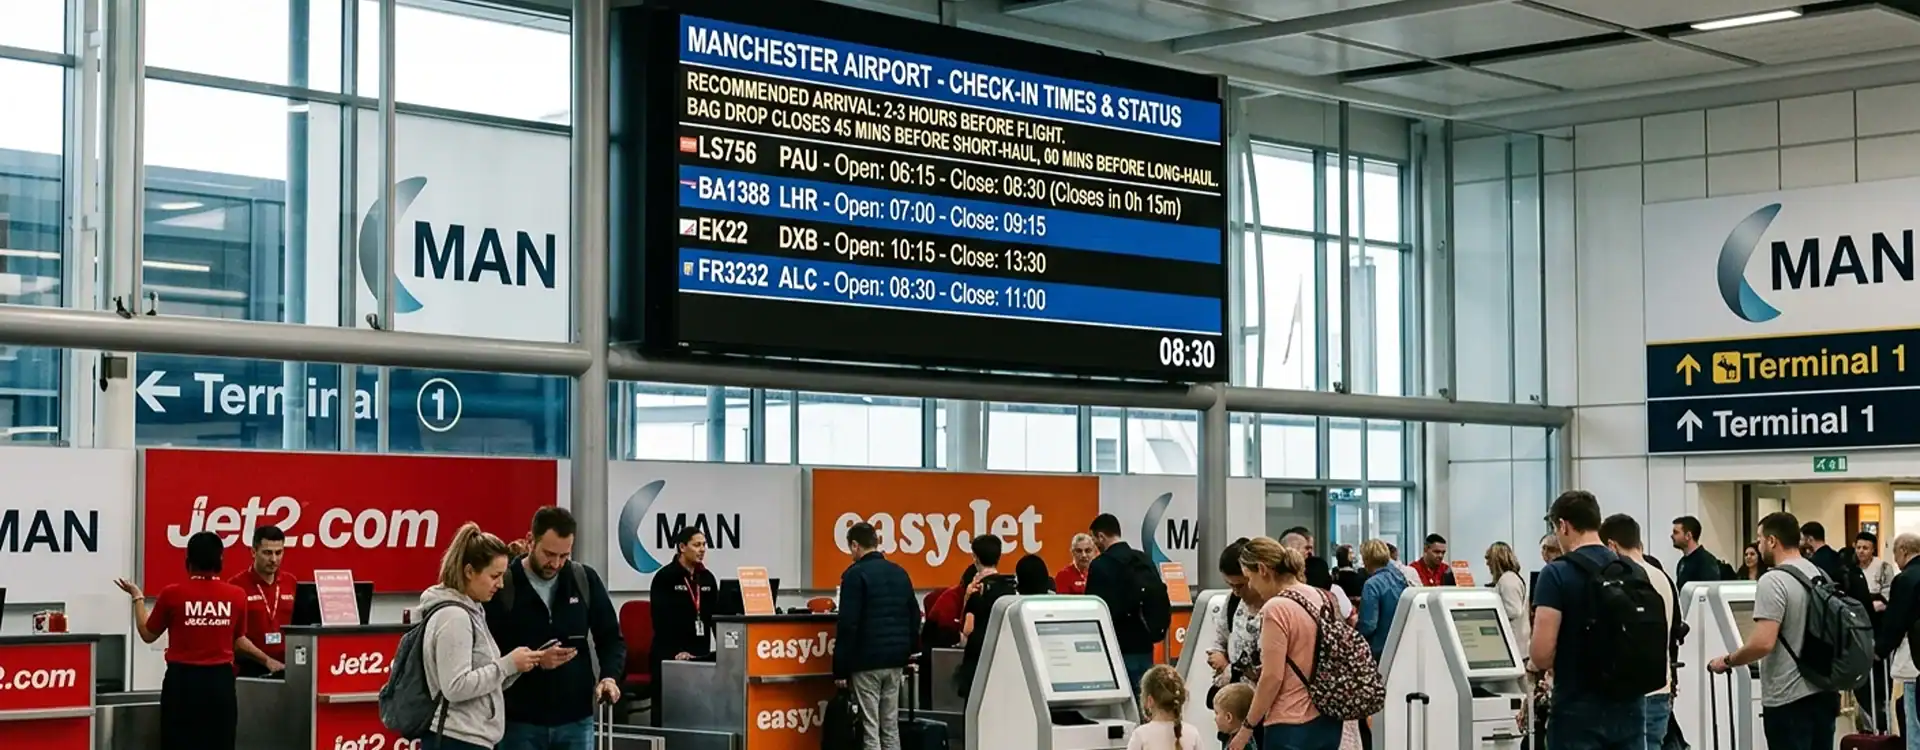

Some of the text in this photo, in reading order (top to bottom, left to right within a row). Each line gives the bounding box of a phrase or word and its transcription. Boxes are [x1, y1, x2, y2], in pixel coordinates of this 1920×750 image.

[688, 26, 839, 75] MANCHESTER
[844, 53, 932, 88] AIRPORT
[949, 70, 1038, 105] CHECK-IN
[1043, 84, 1096, 115] TIMES
[1100, 93, 1114, 118] &
[1117, 97, 1182, 128] STATUS
[687, 72, 1066, 144] RECOMMENDED ARRIVAL: 2-3 HOURS BEFORE FLIGHT.
[687, 97, 721, 119] BAG
[724, 102, 768, 125] DROP
[771, 109, 831, 134] CLOSES
[833, 118, 852, 137] 45
[855, 121, 891, 143] MINS
[894, 126, 949, 151] BEFORE
[952, 135, 1041, 166] SHORT-HAUL,
[1062, 150, 1094, 171] MINS
[1096, 155, 1145, 177] BEFORE
[1148, 162, 1219, 187] LONG-HAUL.
[699, 135, 757, 165] LS756
[779, 145, 817, 171] PAU
[834, 153, 885, 182] Open:
[889, 160, 935, 187] 06:15
[950, 168, 999, 195] Close:
[1003, 175, 1046, 200] 08:30
[1049, 181, 1104, 207] (Closes
[1109, 188, 1121, 210] in
[1124, 191, 1143, 212] 0h
[1146, 194, 1182, 221] 15m)
[699, 176, 770, 206] BA1388
[779, 186, 818, 211] LHR
[834, 192, 885, 221] Open:
[889, 198, 935, 225] 07:00
[950, 205, 999, 231] Close:
[1003, 212, 1046, 237] 09:15
[414, 221, 556, 289] MAN
[699, 217, 748, 245] EK22
[779, 225, 818, 251] DXB
[834, 231, 885, 260] Open:
[890, 238, 935, 263] 10:15
[950, 243, 999, 269] Close:
[1004, 249, 1046, 274] 13:30
[1771, 229, 1914, 291] MAN
[698, 258, 769, 287] FR3232
[778, 266, 817, 291] ALC
[834, 271, 885, 300] Open:
[889, 276, 936, 301] 08:30
[950, 281, 999, 306] Close:
[1005, 286, 1046, 310] 11:00
[1159, 336, 1216, 369] 08:30
[1743, 344, 1905, 380] Terminal 1
[431, 388, 445, 420] 1
[1712, 405, 1875, 438] Terminal 1
[167, 496, 440, 548] jet2.com
[656, 513, 740, 549] MAN
[834, 499, 1043, 567] easyJet
[185, 601, 232, 617] MAN
